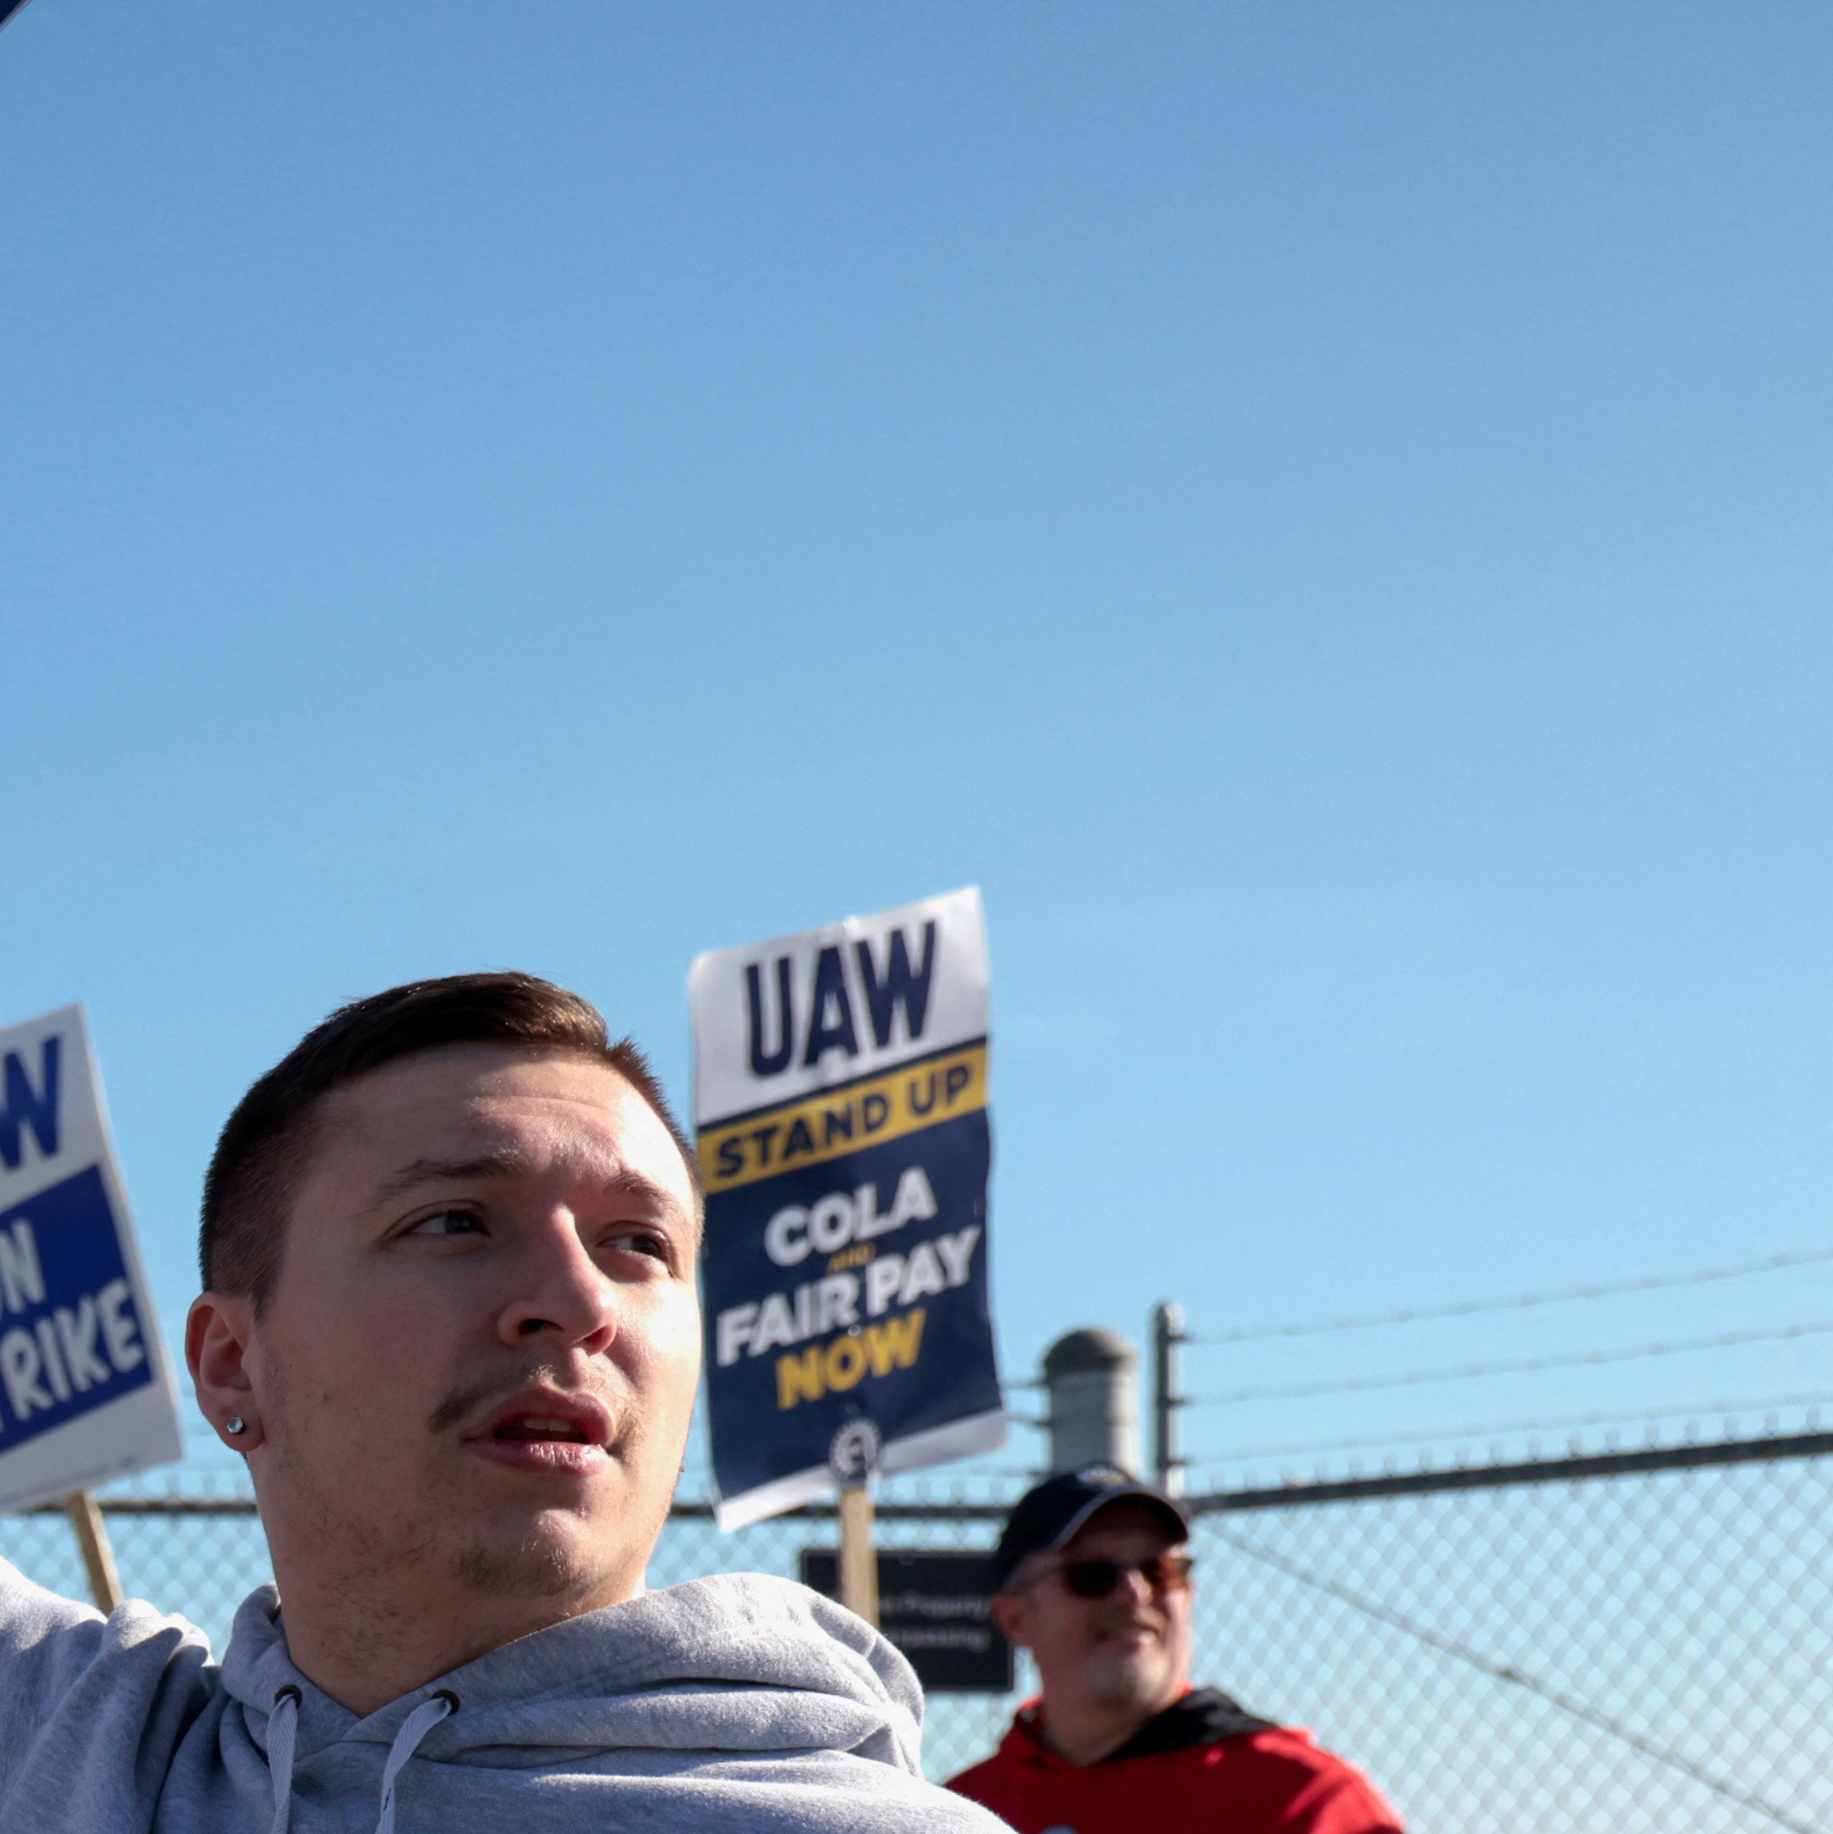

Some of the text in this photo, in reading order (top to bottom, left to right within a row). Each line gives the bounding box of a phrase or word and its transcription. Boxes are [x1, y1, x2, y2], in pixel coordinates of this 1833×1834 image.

[745, 919, 938, 1078] UAW
[717, 1060, 974, 1180] STAND UP
[764, 1165, 937, 1268] COLA
[716, 1224, 983, 1368] FAIR PAY
[774, 1308, 928, 1411] NOW
